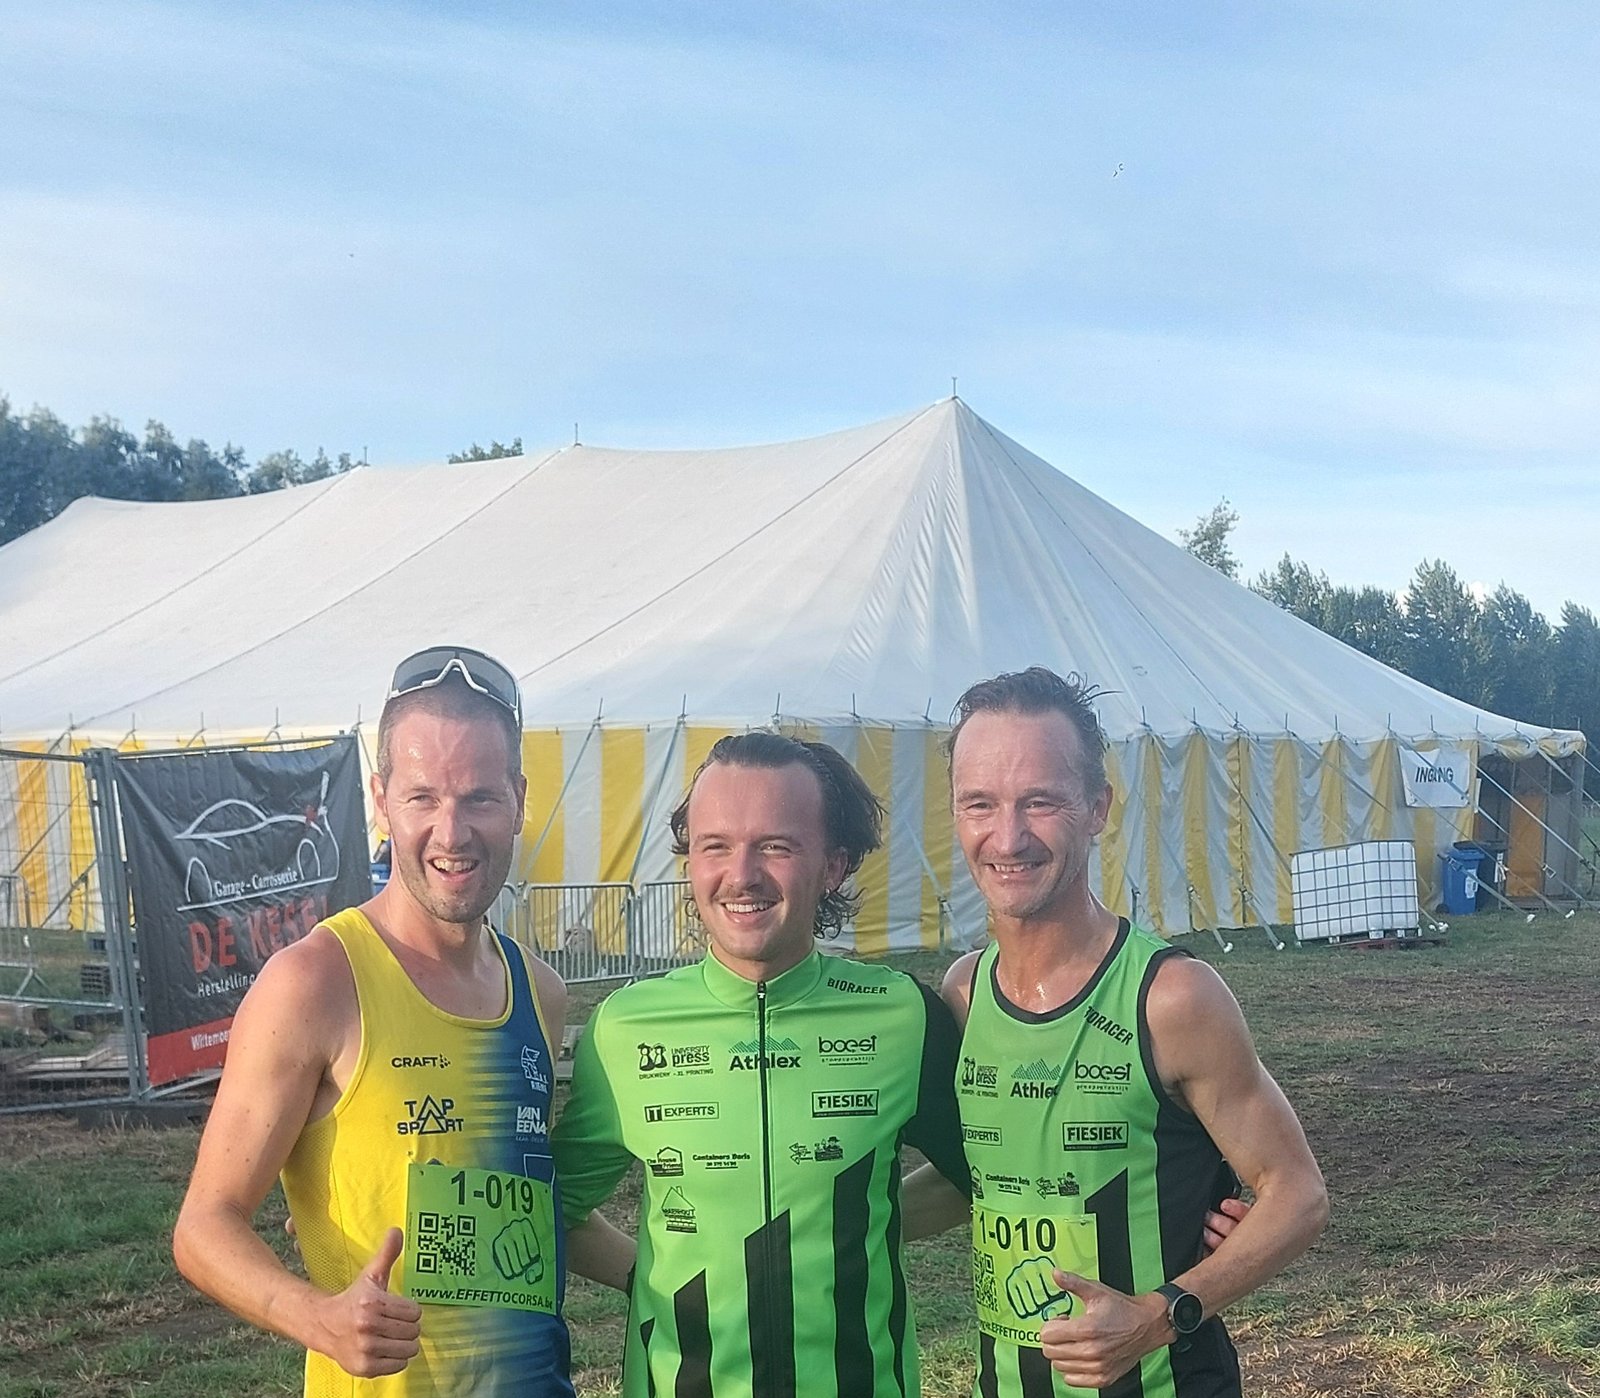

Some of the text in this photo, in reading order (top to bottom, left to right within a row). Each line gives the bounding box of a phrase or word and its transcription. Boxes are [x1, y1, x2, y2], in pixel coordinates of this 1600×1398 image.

[1415, 766, 1454, 783] INGANG
[188, 916, 237, 974] DE
[827, 977, 888, 995] BIORACER
[391, 1057, 438, 1068] CRAFT
[672, 1052, 710, 1067] press
[728, 1053, 802, 1072] Athlex
[817, 1094, 874, 1109] FIESIEK
[517, 1106, 541, 1120] VAN
[664, 1105, 716, 1117] EXPERTS
[1066, 1126, 1123, 1141] FIESIEK
[450, 1170, 534, 1215] 1-019
[979, 1210, 1057, 1253] 1-010
